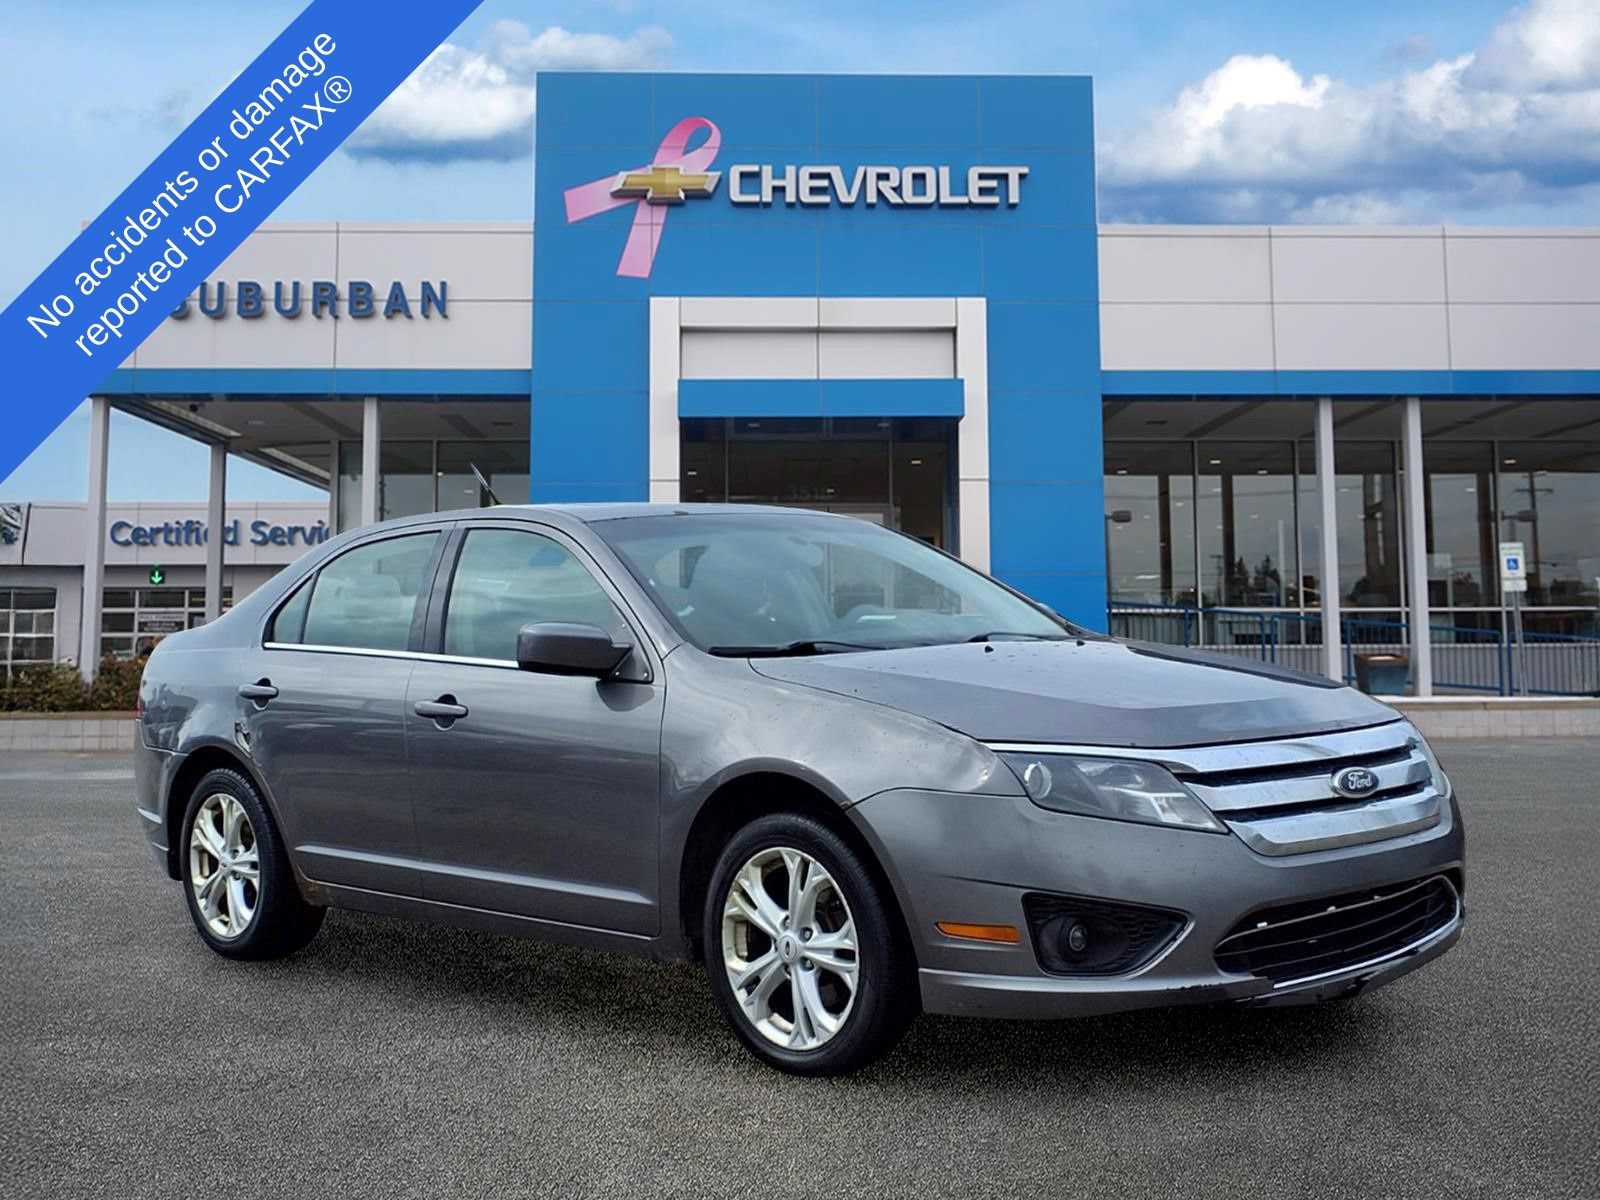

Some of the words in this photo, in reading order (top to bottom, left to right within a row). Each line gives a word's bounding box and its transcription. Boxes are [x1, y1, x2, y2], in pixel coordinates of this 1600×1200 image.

[729, 164, 1029, 206] CHEVROLET
[110, 520, 241, 547] Certifid
[1348, 771, 1373, 790] Ford
